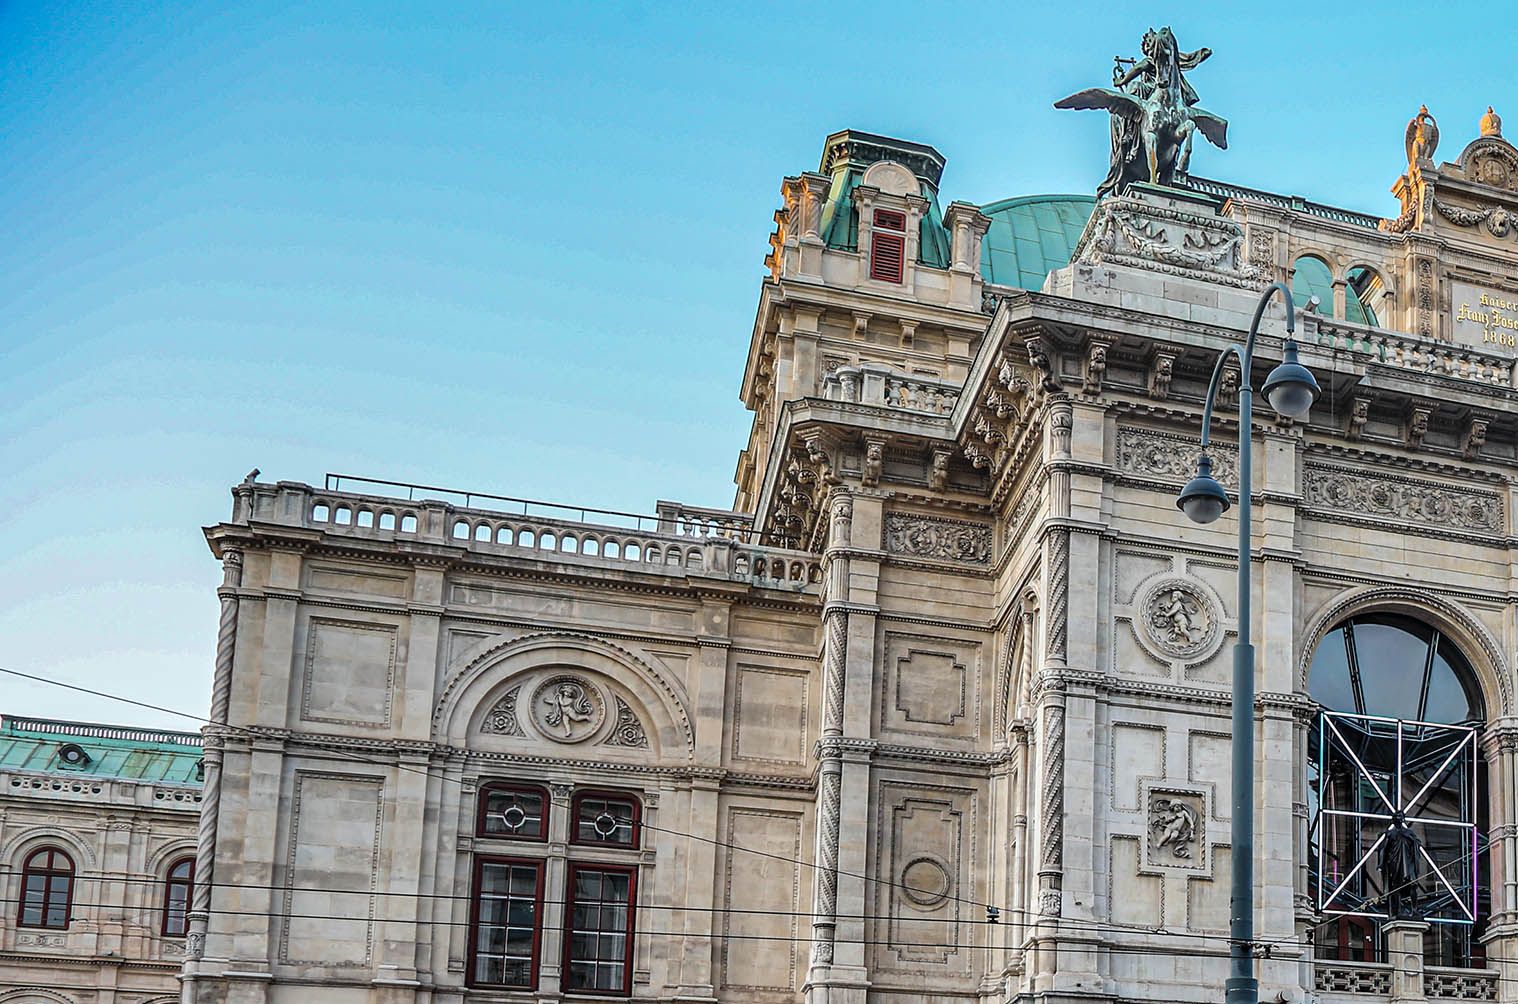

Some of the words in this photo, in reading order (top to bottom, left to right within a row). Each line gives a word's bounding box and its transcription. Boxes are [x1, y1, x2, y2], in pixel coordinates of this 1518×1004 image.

[1480, 292, 1518, 312] Kaiser
[1456, 303, 1490, 329] Franz
[1482, 328, 1515, 347] 1868
